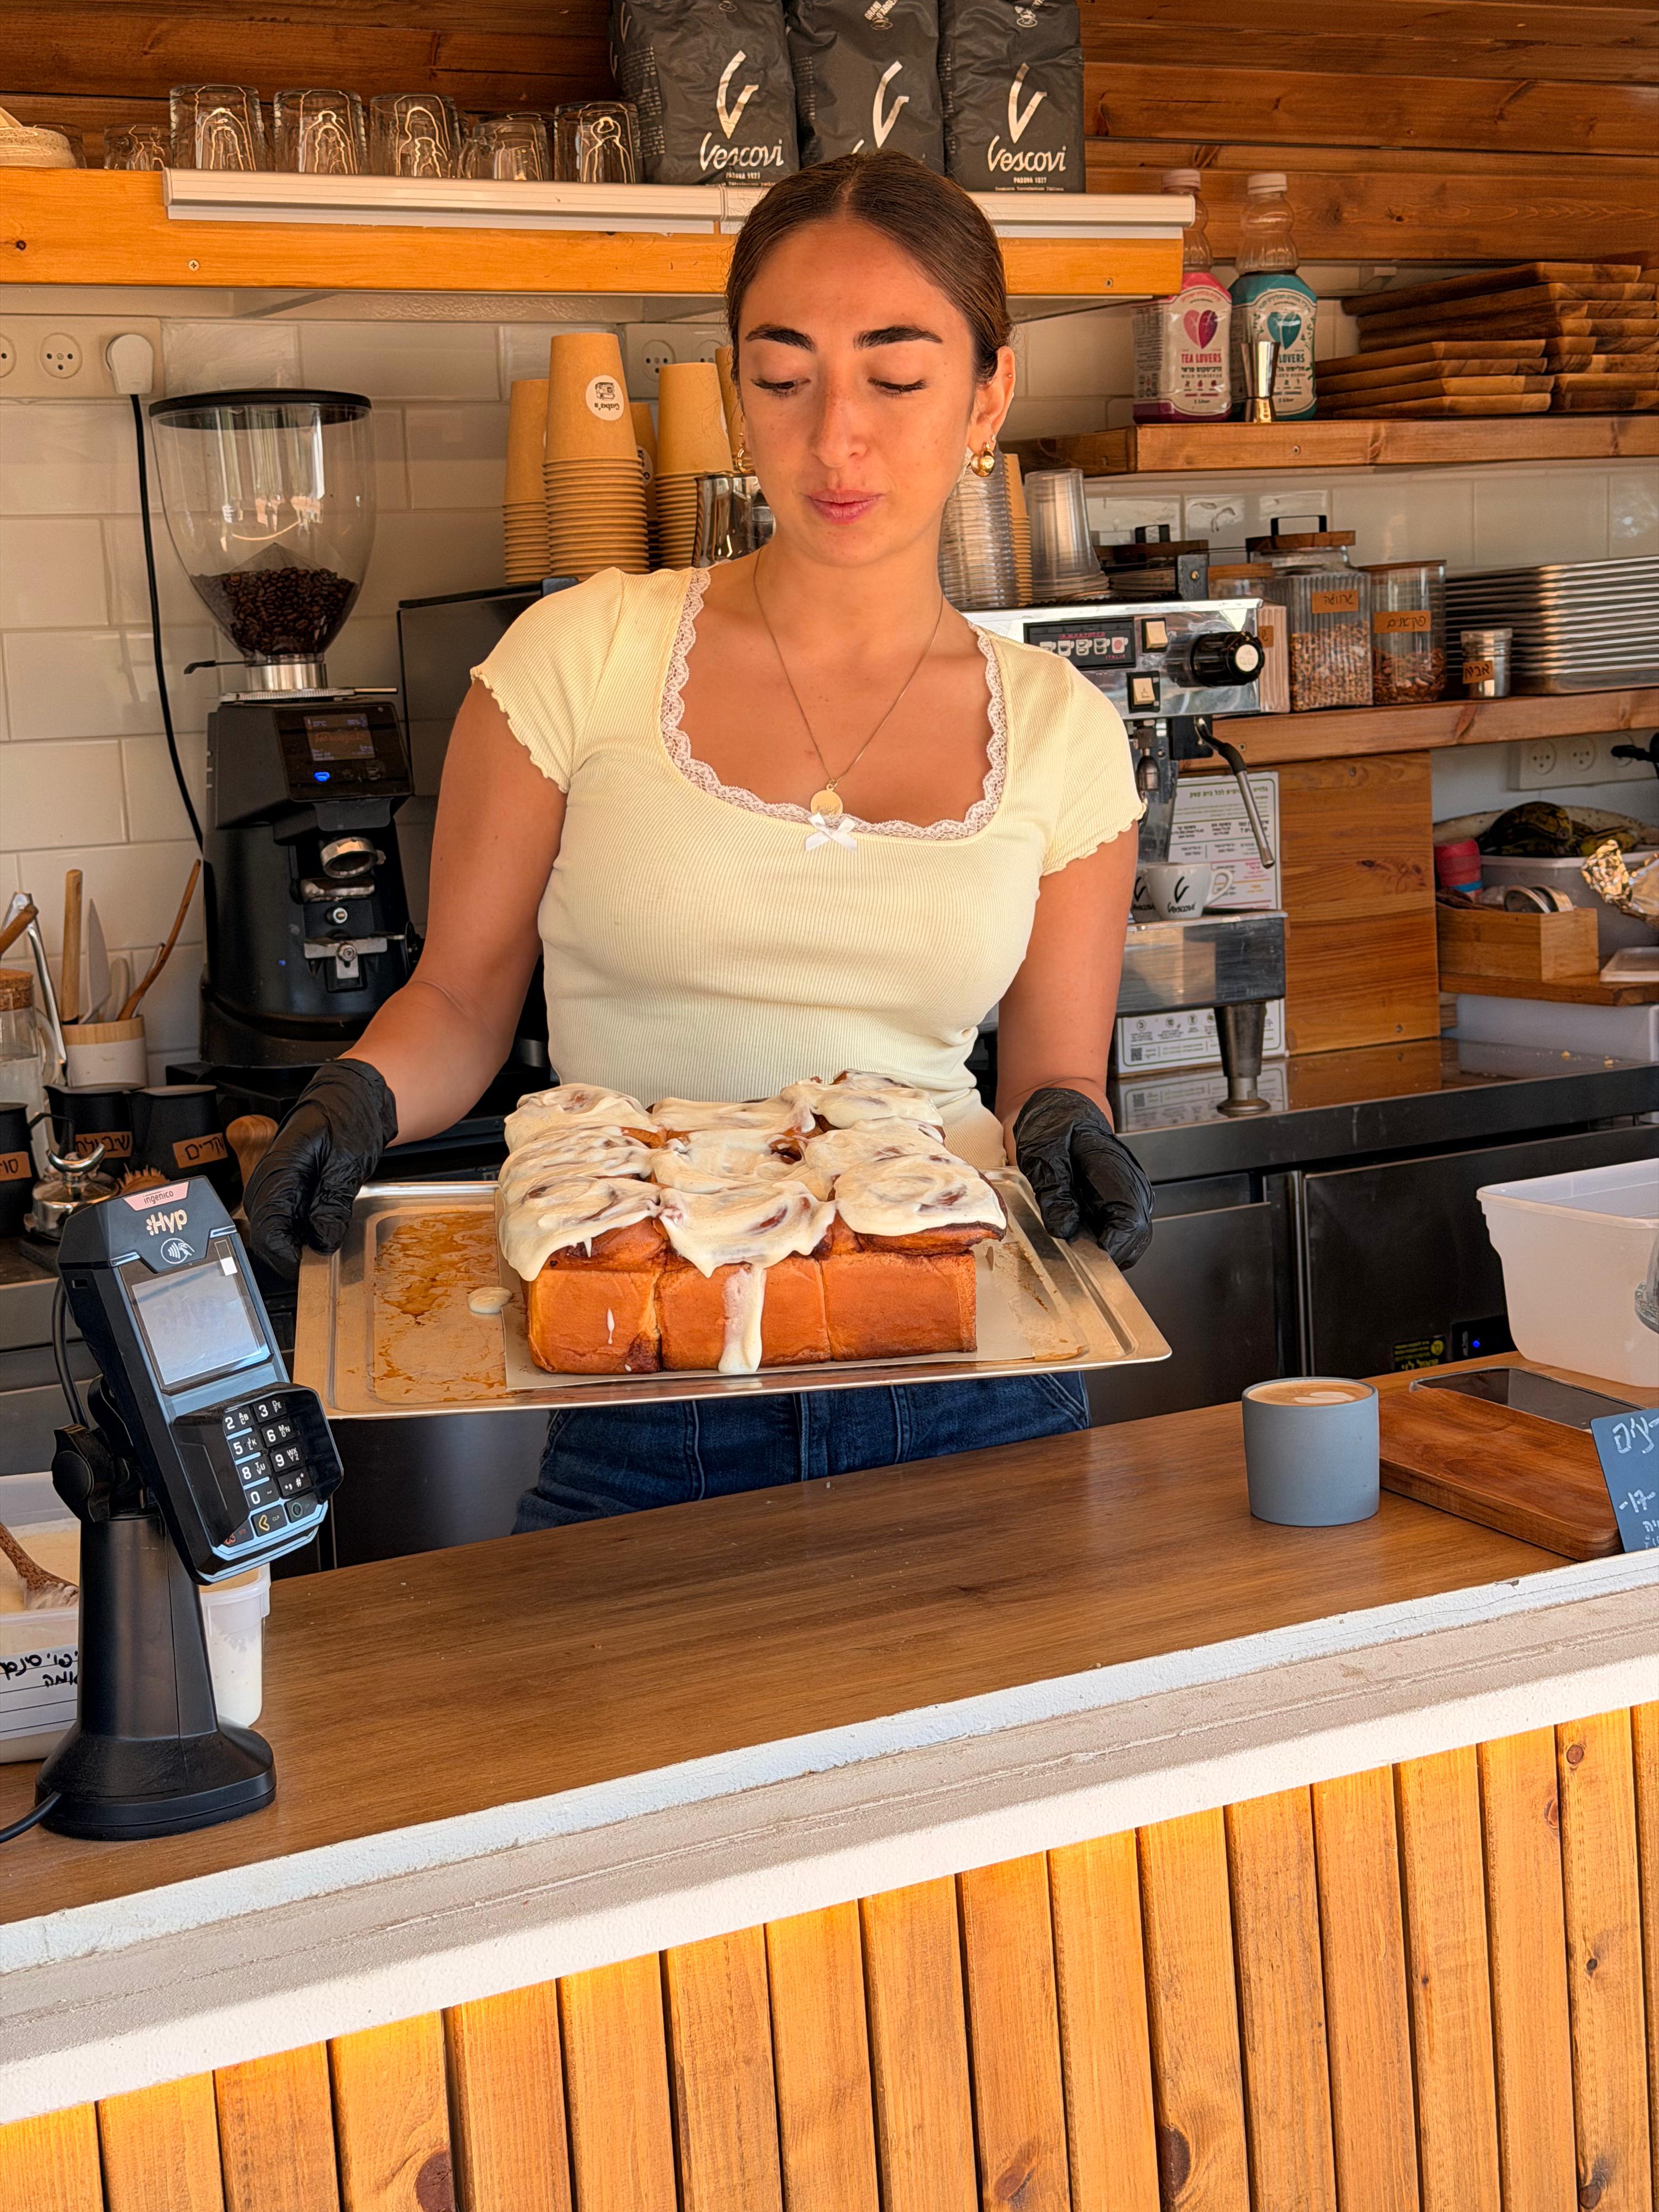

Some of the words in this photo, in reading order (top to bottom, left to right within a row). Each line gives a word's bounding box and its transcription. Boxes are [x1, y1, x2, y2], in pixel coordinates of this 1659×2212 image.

[699, 132, 784, 172] Vescovi
[988, 135, 1066, 172] Vescovi
[1181, 353, 1194, 363] TEA
[1195, 353, 1222, 363] LOVERS
[1278, 353, 1305, 363] LOVERS
[185, 1133, 225, 1160] קדים
[0, 1158, 19, 1174] סו
[143, 1190, 174, 1205] ingenico
[150, 1209, 188, 1234] Hyp
[258, 1404, 268, 1418] 3
[225, 1417, 235, 1430] 2
[267, 1429, 276, 1442] 6
[233, 1442, 243, 1455] 5
[275, 1454, 285, 1467] 9
[242, 1466, 252, 1480] 8
[250, 1491, 261, 1504] 0
